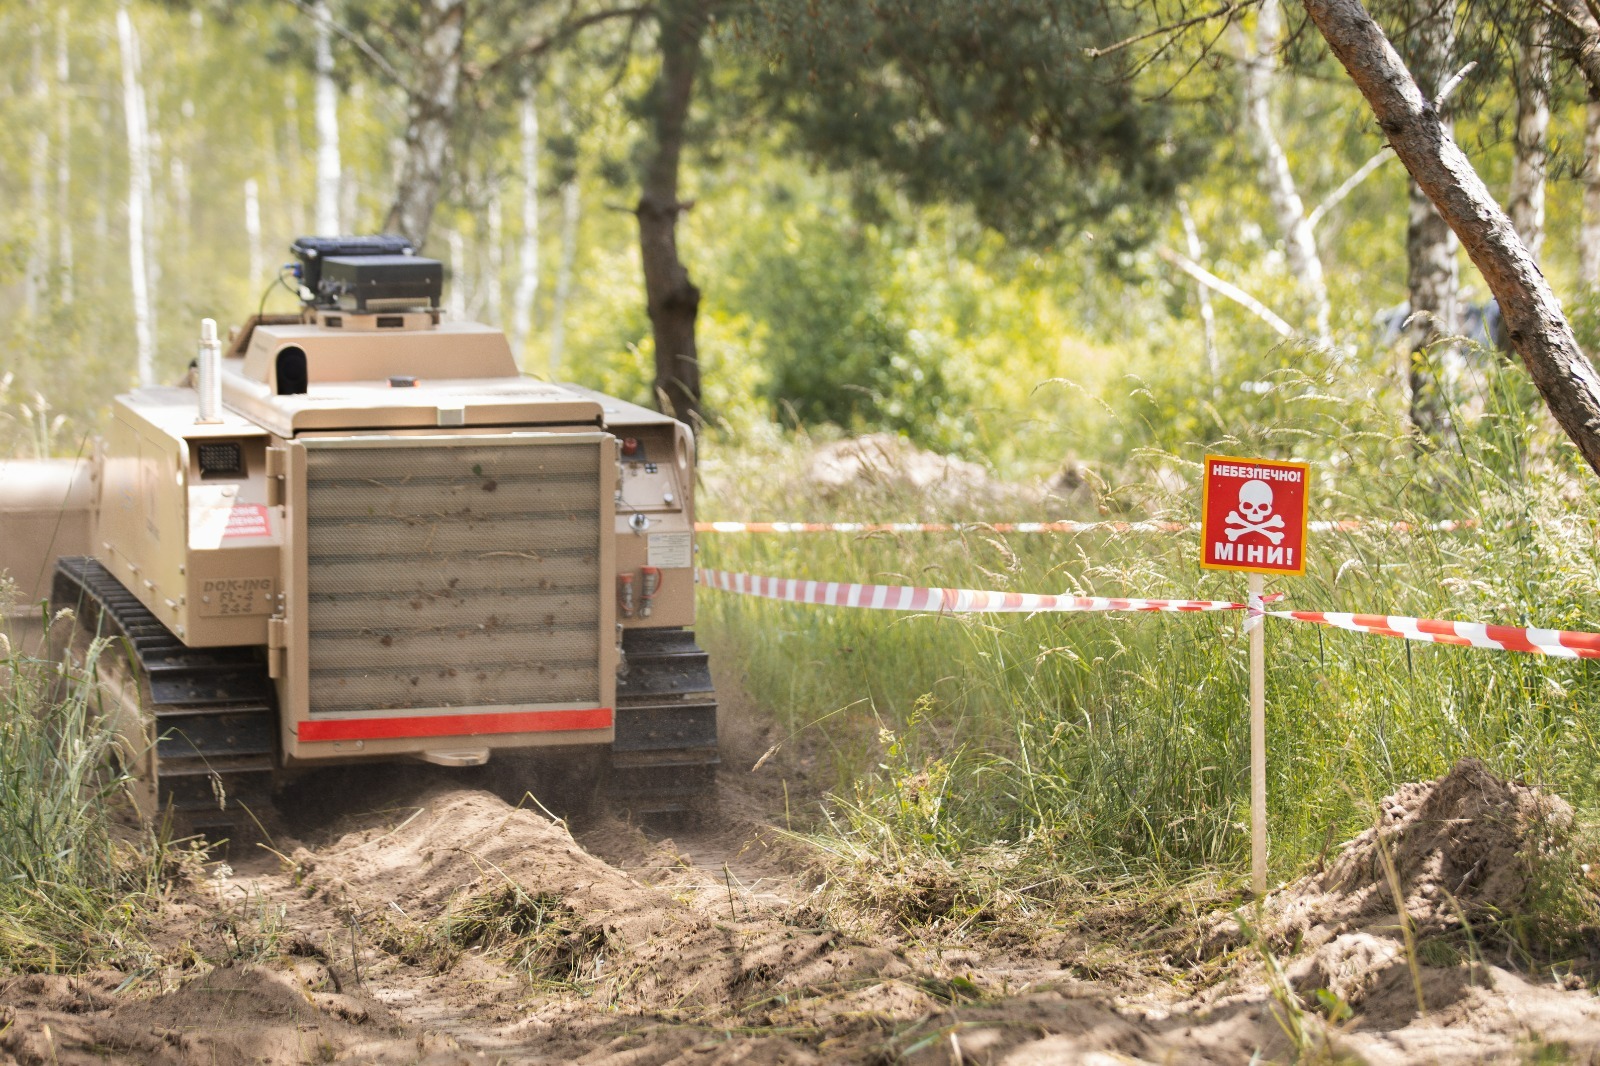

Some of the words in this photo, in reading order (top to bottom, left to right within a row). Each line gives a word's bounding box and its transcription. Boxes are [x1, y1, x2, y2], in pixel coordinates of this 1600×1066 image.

[1212, 464, 1301, 483] НЕБЕЗПЕЧНО!
[1214, 541, 1293, 566] МІНИ!
[203, 579, 271, 592] DOK-ING
